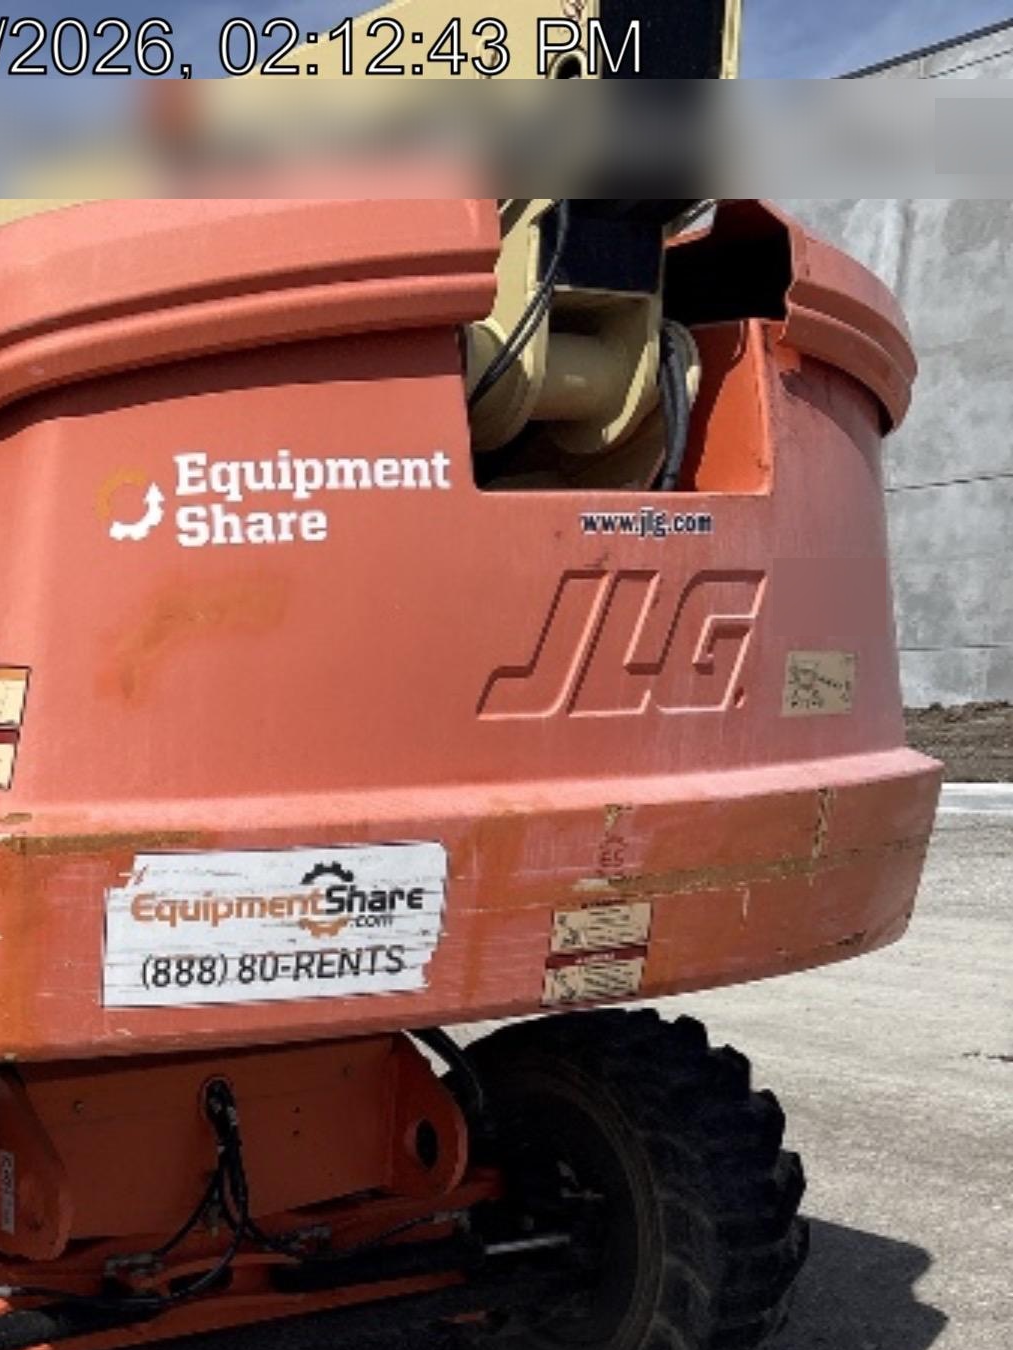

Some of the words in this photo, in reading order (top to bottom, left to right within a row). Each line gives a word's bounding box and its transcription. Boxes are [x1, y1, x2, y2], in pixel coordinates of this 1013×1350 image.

[173, 449, 451, 501] Equipment
[175, 504, 328, 547] Share
[581, 506, 715, 540] www.jlg.com
[477, 569, 768, 720] JLG
[142, 953, 228, 990] (888)
[237, 944, 406, 984] 80-RENTS
